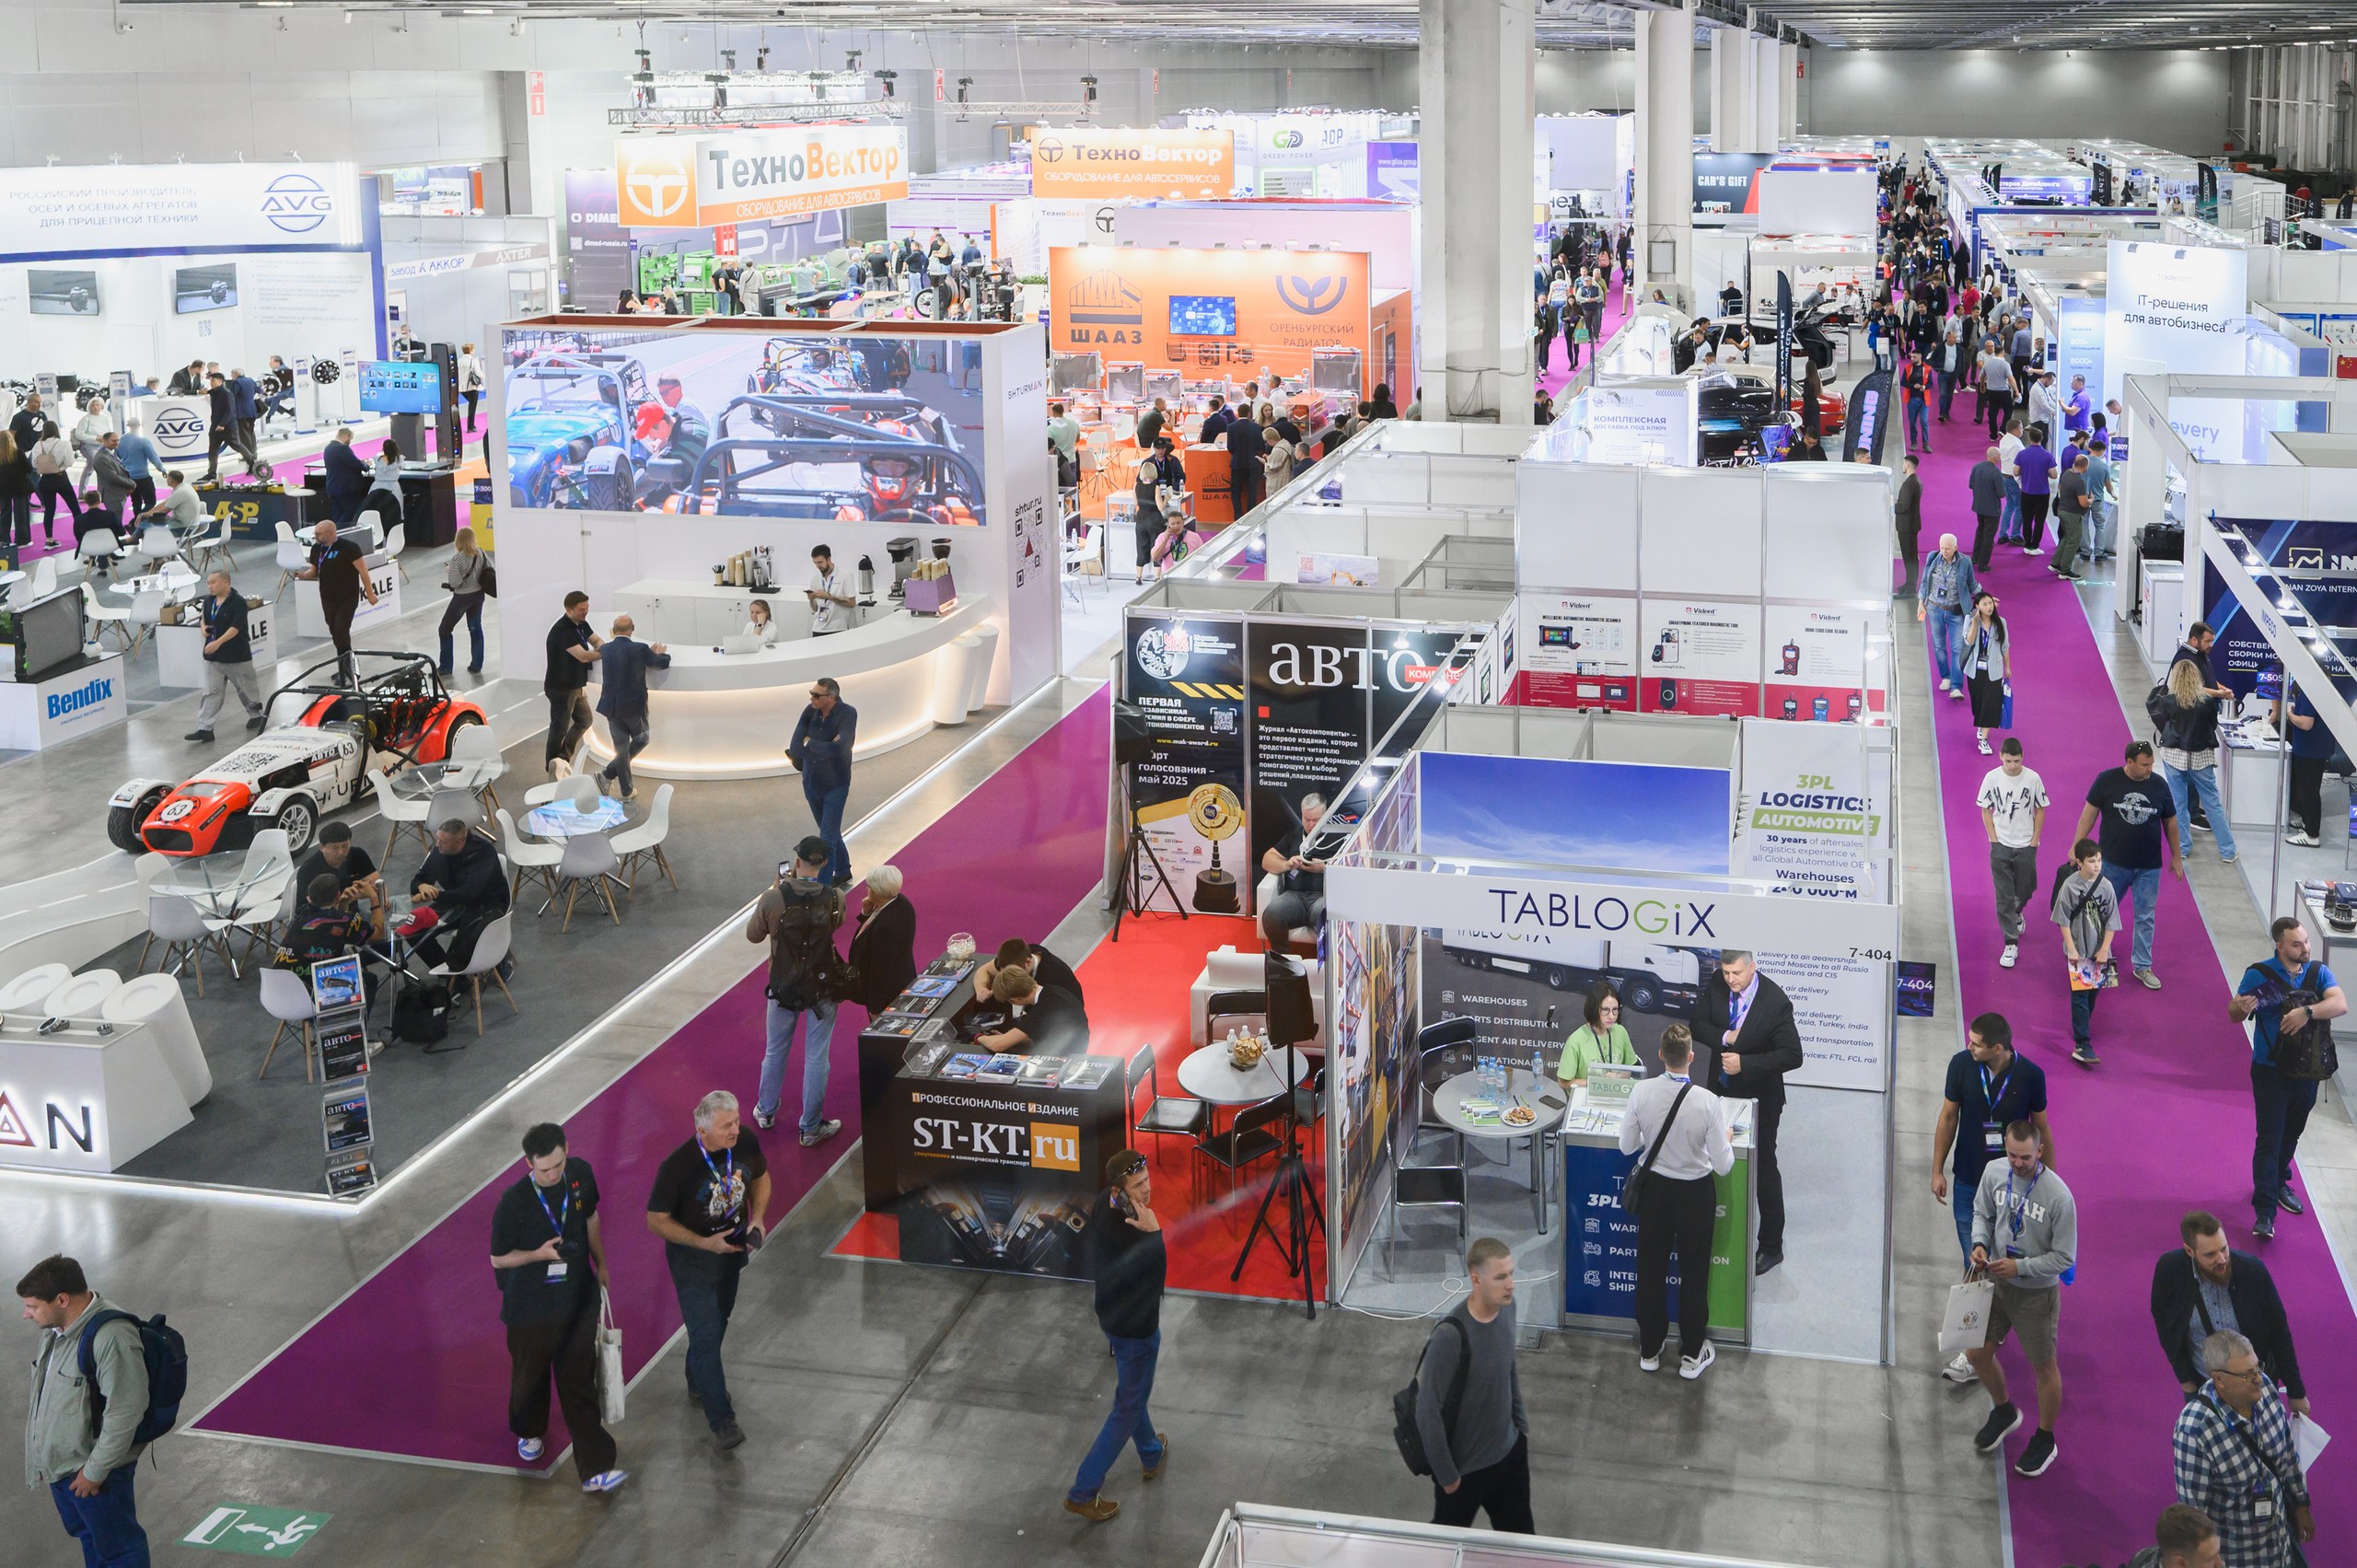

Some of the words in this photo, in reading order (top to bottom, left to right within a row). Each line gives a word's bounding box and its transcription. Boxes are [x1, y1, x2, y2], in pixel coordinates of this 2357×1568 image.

[1072, 144, 1223, 165] ТехноВектор
[709, 142, 899, 190] ТехноВектор
[1043, 172, 1121, 183] ОБОРУДОВАНИЕ
[1122, 173, 1143, 183] ДЛЯ
[1144, 173, 1221, 184] АВТОСЕРВИСОВ
[1698, 175, 1726, 187] CAR'S
[1728, 176, 1747, 187] GIFT
[9, 189, 92, 200] РОССИЙСКИЙ
[96, 187, 197, 198] ПРОИЗВОДИТЕЛЬ
[29, 203, 63, 214] ОСЕЙ
[78, 203, 129, 213] ОСЕВЫХ
[133, 201, 198, 211] АГРЕГАТОВ
[260, 195, 331, 213] AVG
[737, 200, 805, 217] ОБОРУДОВАНИЕ
[806, 195, 824, 211] ДЛЯ
[823, 189, 882, 209] АВТОСЕРВИСОВ
[586, 213, 618, 223] DIME
[1041, 209, 1085, 217] ТехноВект
[40, 217, 64, 228] ДЛЯ
[68, 214, 143, 226] ПРИЦЕПНОЙ
[147, 214, 199, 224] ТЕХНИКИ
[495, 247, 532, 262] AXTER
[2137, 294, 2209, 313] IT-решения
[1270, 321, 1353, 335] ОРЕНБУРГСКИЙ
[2124, 313, 2145, 324] для
[2148, 315, 2226, 333] автобизнеса
[1070, 329, 1143, 344] ШААЗ
[1283, 337, 1341, 348] РАДИАТОР
[1594, 415, 1666, 424] КОМПЛЕКСНАЯ
[153, 420, 204, 435] AVG
[2170, 421, 2220, 445] every
[1015, 495, 1042, 517] shtur.ru
[2228, 650, 2263, 659] СБОРКИ
[1269, 643, 1425, 692] авто
[2258, 673, 2283, 682] 7-505
[47, 678, 113, 719] Bendix
[1139, 696, 1181, 708] ПЕРВАЯ
[1146, 721, 1205, 732] ТОКОМПОНЕНТОВ
[1259, 725, 1285, 734] Журнал
[1286, 726, 1350, 738] «Автокомпоненты»
[343, 742, 354, 754] 63
[1156, 738, 1218, 747] www.mak-award.ru
[1297, 738, 1329, 746] издание,
[1330, 739, 1358, 748] которое
[1259, 744, 1306, 752] представляет
[1306, 747, 1340, 755] читателю
[1259, 753, 1314, 763] стратегическую
[1315, 756, 1362, 766] информацию,
[1138, 763, 1206, 774] голосования
[1259, 763, 1305, 772] помогающую
[1311, 765, 1338, 773] выборе
[1138, 774, 1160, 784] май
[1162, 775, 1188, 785] 2025
[1259, 779, 1288, 787] бизнеса
[1796, 774, 1835, 790] 3PL
[1760, 792, 1872, 812] LOGISTICS
[167, 804, 185, 816] 63
[1767, 834, 1779, 842] 30
[1781, 836, 1807, 844] years
[1809, 837, 1818, 845] of
[1820, 838, 1864, 848] aftersales
[1759, 844, 1796, 854] logistics
[1798, 848, 1848, 857] experience
[1764, 854, 1794, 864] Global
[1795, 857, 1849, 867] Automotive
[1851, 862, 1877, 870] OEs
[1776, 869, 1854, 884] Warehouses
[1489, 889, 1716, 938] TABLOGiX
[1850, 947, 1892, 961] 7-404
[1757, 967, 1805, 976] destinations
[1807, 970, 1823, 978] and
[1825, 970, 1838, 979] CIS
[1787, 961, 1820, 970] Moscow
[1831, 963, 1841, 971] all
[1843, 965, 1869, 973] Russia
[1799, 985, 1829, 995] delivery
[1898, 978, 1933, 991] 7-404
[1462, 994, 1527, 1007] WAREHOUSES
[1809, 1010, 1841, 1020] delivery:
[1797, 1018, 1817, 1027] Asia,
[1818, 1020, 1846, 1030] Turkey,
[1848, 1022, 1868, 1030] India
[1477, 1036, 1500, 1044] GENT
[1502, 1038, 1517, 1047] AIR
[1519, 1040, 1565, 1050] DELIVERY
[1817, 1036, 1874, 1047] transportation
[1804, 1051, 1828, 1060] rvices:
[1829, 1053, 1845, 1062] FTL,
[1864, 1056, 1877, 1064] rail
[912, 1092, 1027, 1112] ПРОФЕССИОНАЛЬНОЕ
[1028, 1102, 1079, 1117] ИЗДАНИЕ
[913, 1117, 1078, 1162] ST-KT.ru
[956, 1155, 999, 1164] коммерческий
[1587, 1193, 1622, 1209] 3PL
[1995, 1190, 2046, 1224] UTAH
[1609, 1247, 1638, 1258] PART
